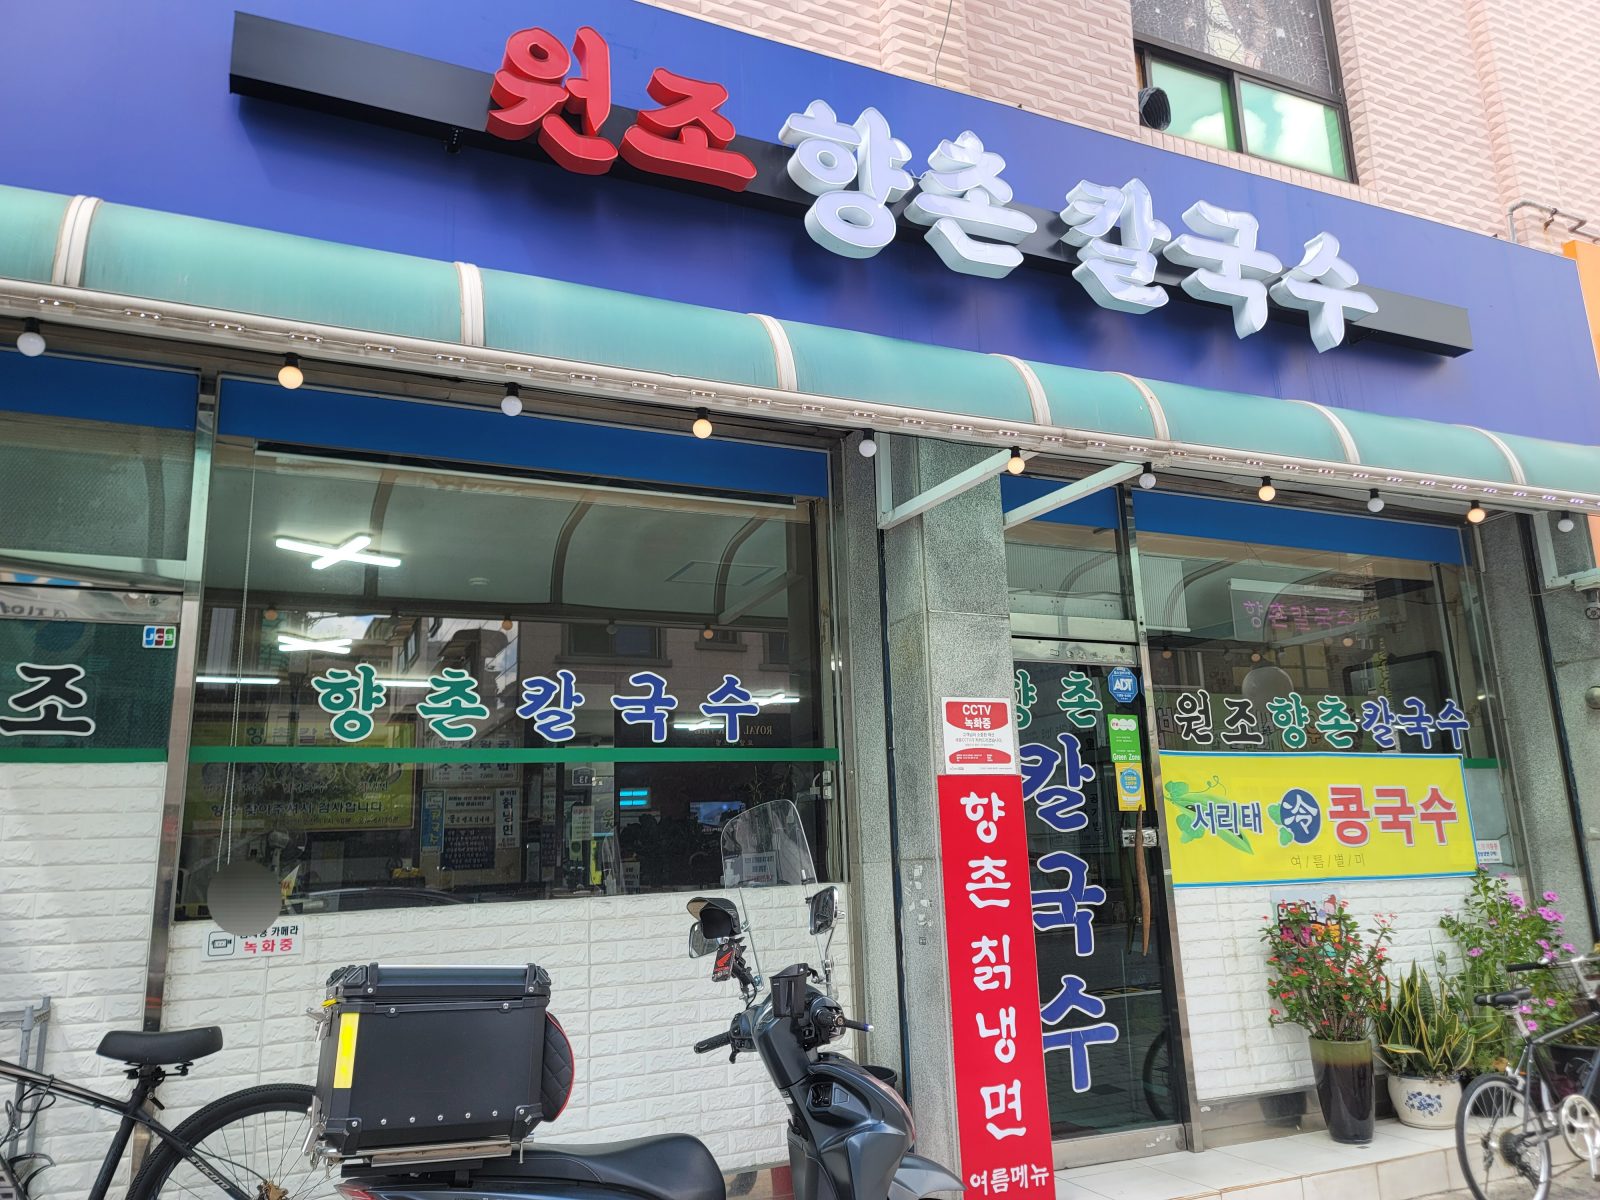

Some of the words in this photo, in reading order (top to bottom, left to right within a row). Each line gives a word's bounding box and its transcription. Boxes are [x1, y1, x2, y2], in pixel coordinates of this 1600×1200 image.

[486, 26, 757, 191] 원조
[778, 99, 1038, 279] 향촌
[1059, 178, 1378, 353] 칼국수
[144, 626, 176, 647] JCB
[0, 662, 97, 738] 조
[1113, 678, 1132, 692] ADT
[311, 664, 489, 743] 향촌
[515, 669, 760, 743] 칼국수
[962, 704, 991, 716] CCTV
[1173, 689, 1264, 745] 원조
[1266, 692, 1358, 749] 향촌
[1361, 695, 1471, 750] 칼국수
[963, 716, 991, 730] 녹화중
[1112, 752, 1128, 761] Green
[1128, 753, 1141, 761] Zone
[1190, 800, 1263, 836] 서리태
[1327, 784, 1459, 848] 콩국수
[960, 791, 1011, 909] 향촌
[243, 938, 293, 954] 녹화중
[271, 925, 299, 937] 카메라
[970, 934, 1027, 1140] 칡냉면
[969, 1163, 1050, 1196] 여름메뉴
